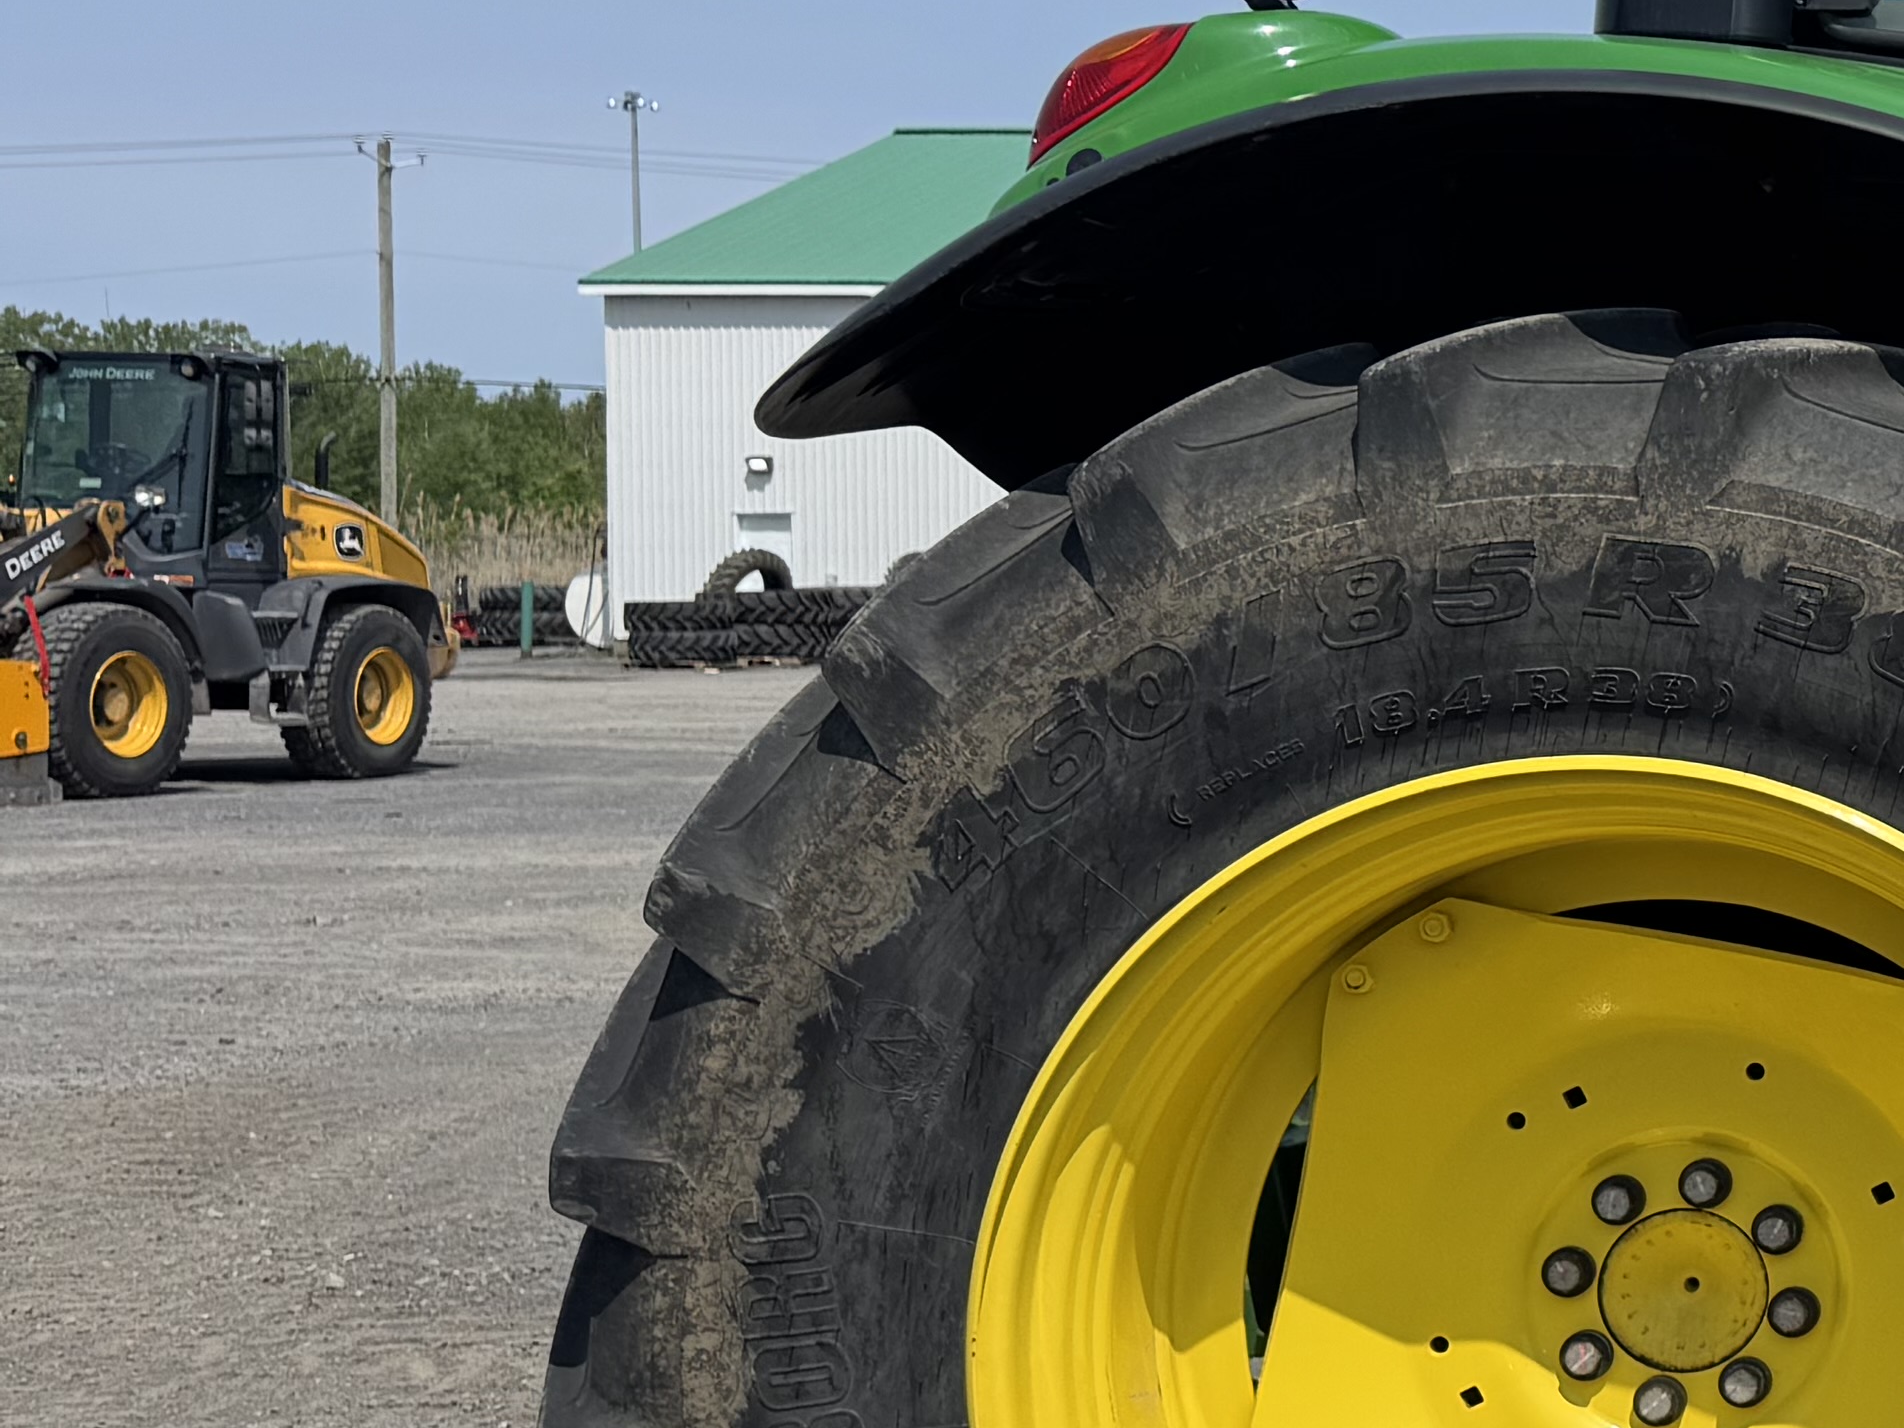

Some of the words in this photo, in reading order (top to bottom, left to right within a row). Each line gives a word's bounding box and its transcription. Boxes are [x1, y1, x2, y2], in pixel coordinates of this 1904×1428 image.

[68, 367, 104, 380] JOHN
[106, 366, 156, 381] DEERE
[4, 529, 66, 580] DEERE
